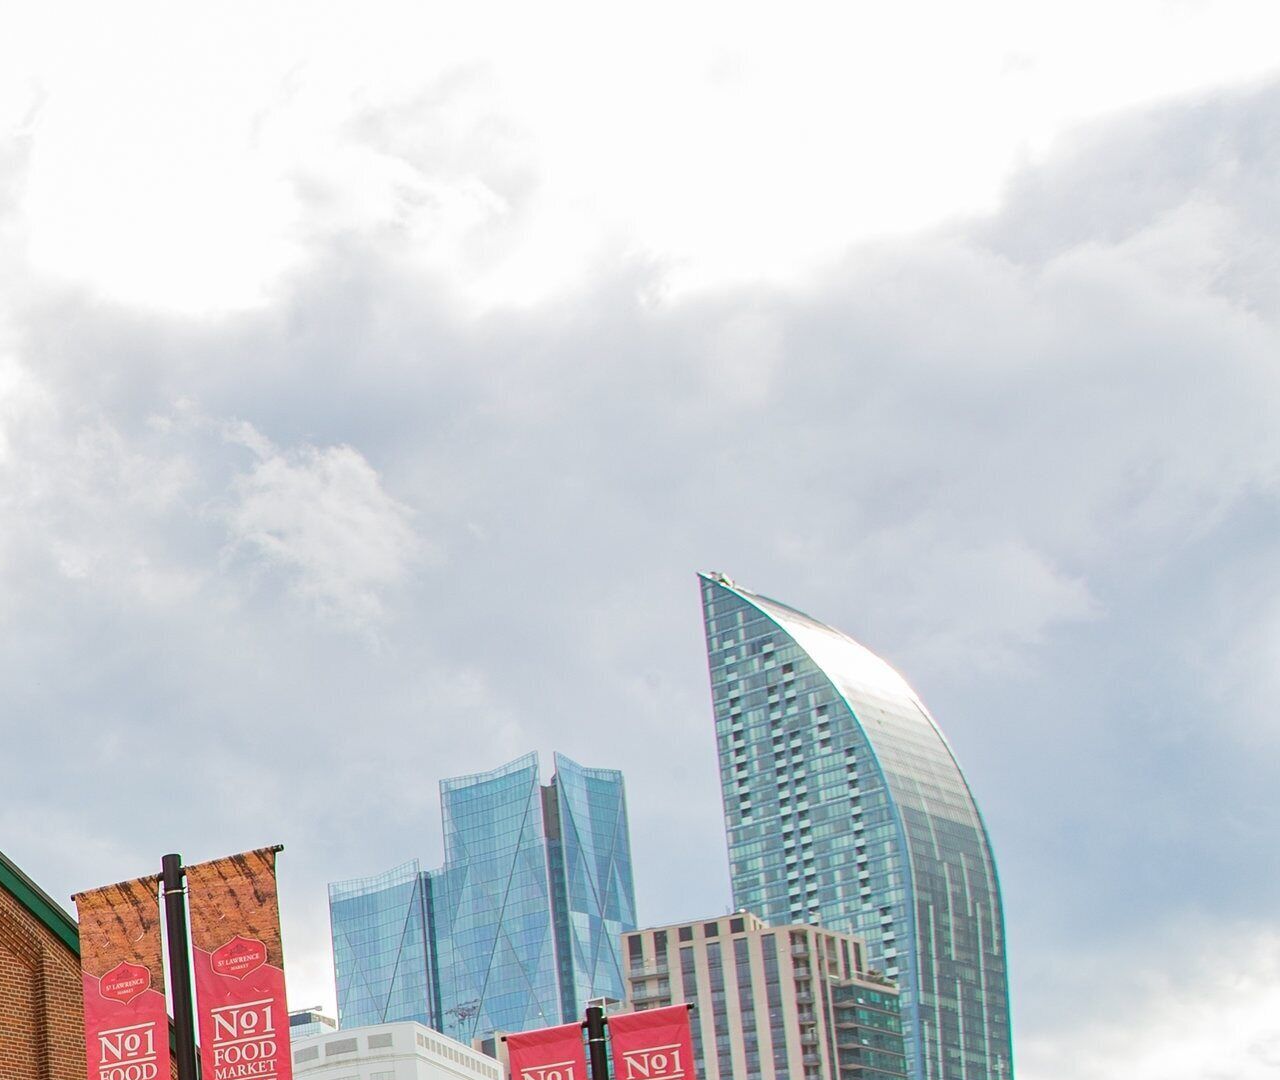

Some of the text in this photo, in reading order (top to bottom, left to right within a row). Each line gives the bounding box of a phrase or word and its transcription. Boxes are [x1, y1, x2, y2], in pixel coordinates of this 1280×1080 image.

[225, 953, 260, 965] LAWRENCE
[112, 978, 144, 990] LAWRENCE
[213, 1040, 277, 1067] FOOD
[214, 1059, 277, 1080] MARKET
